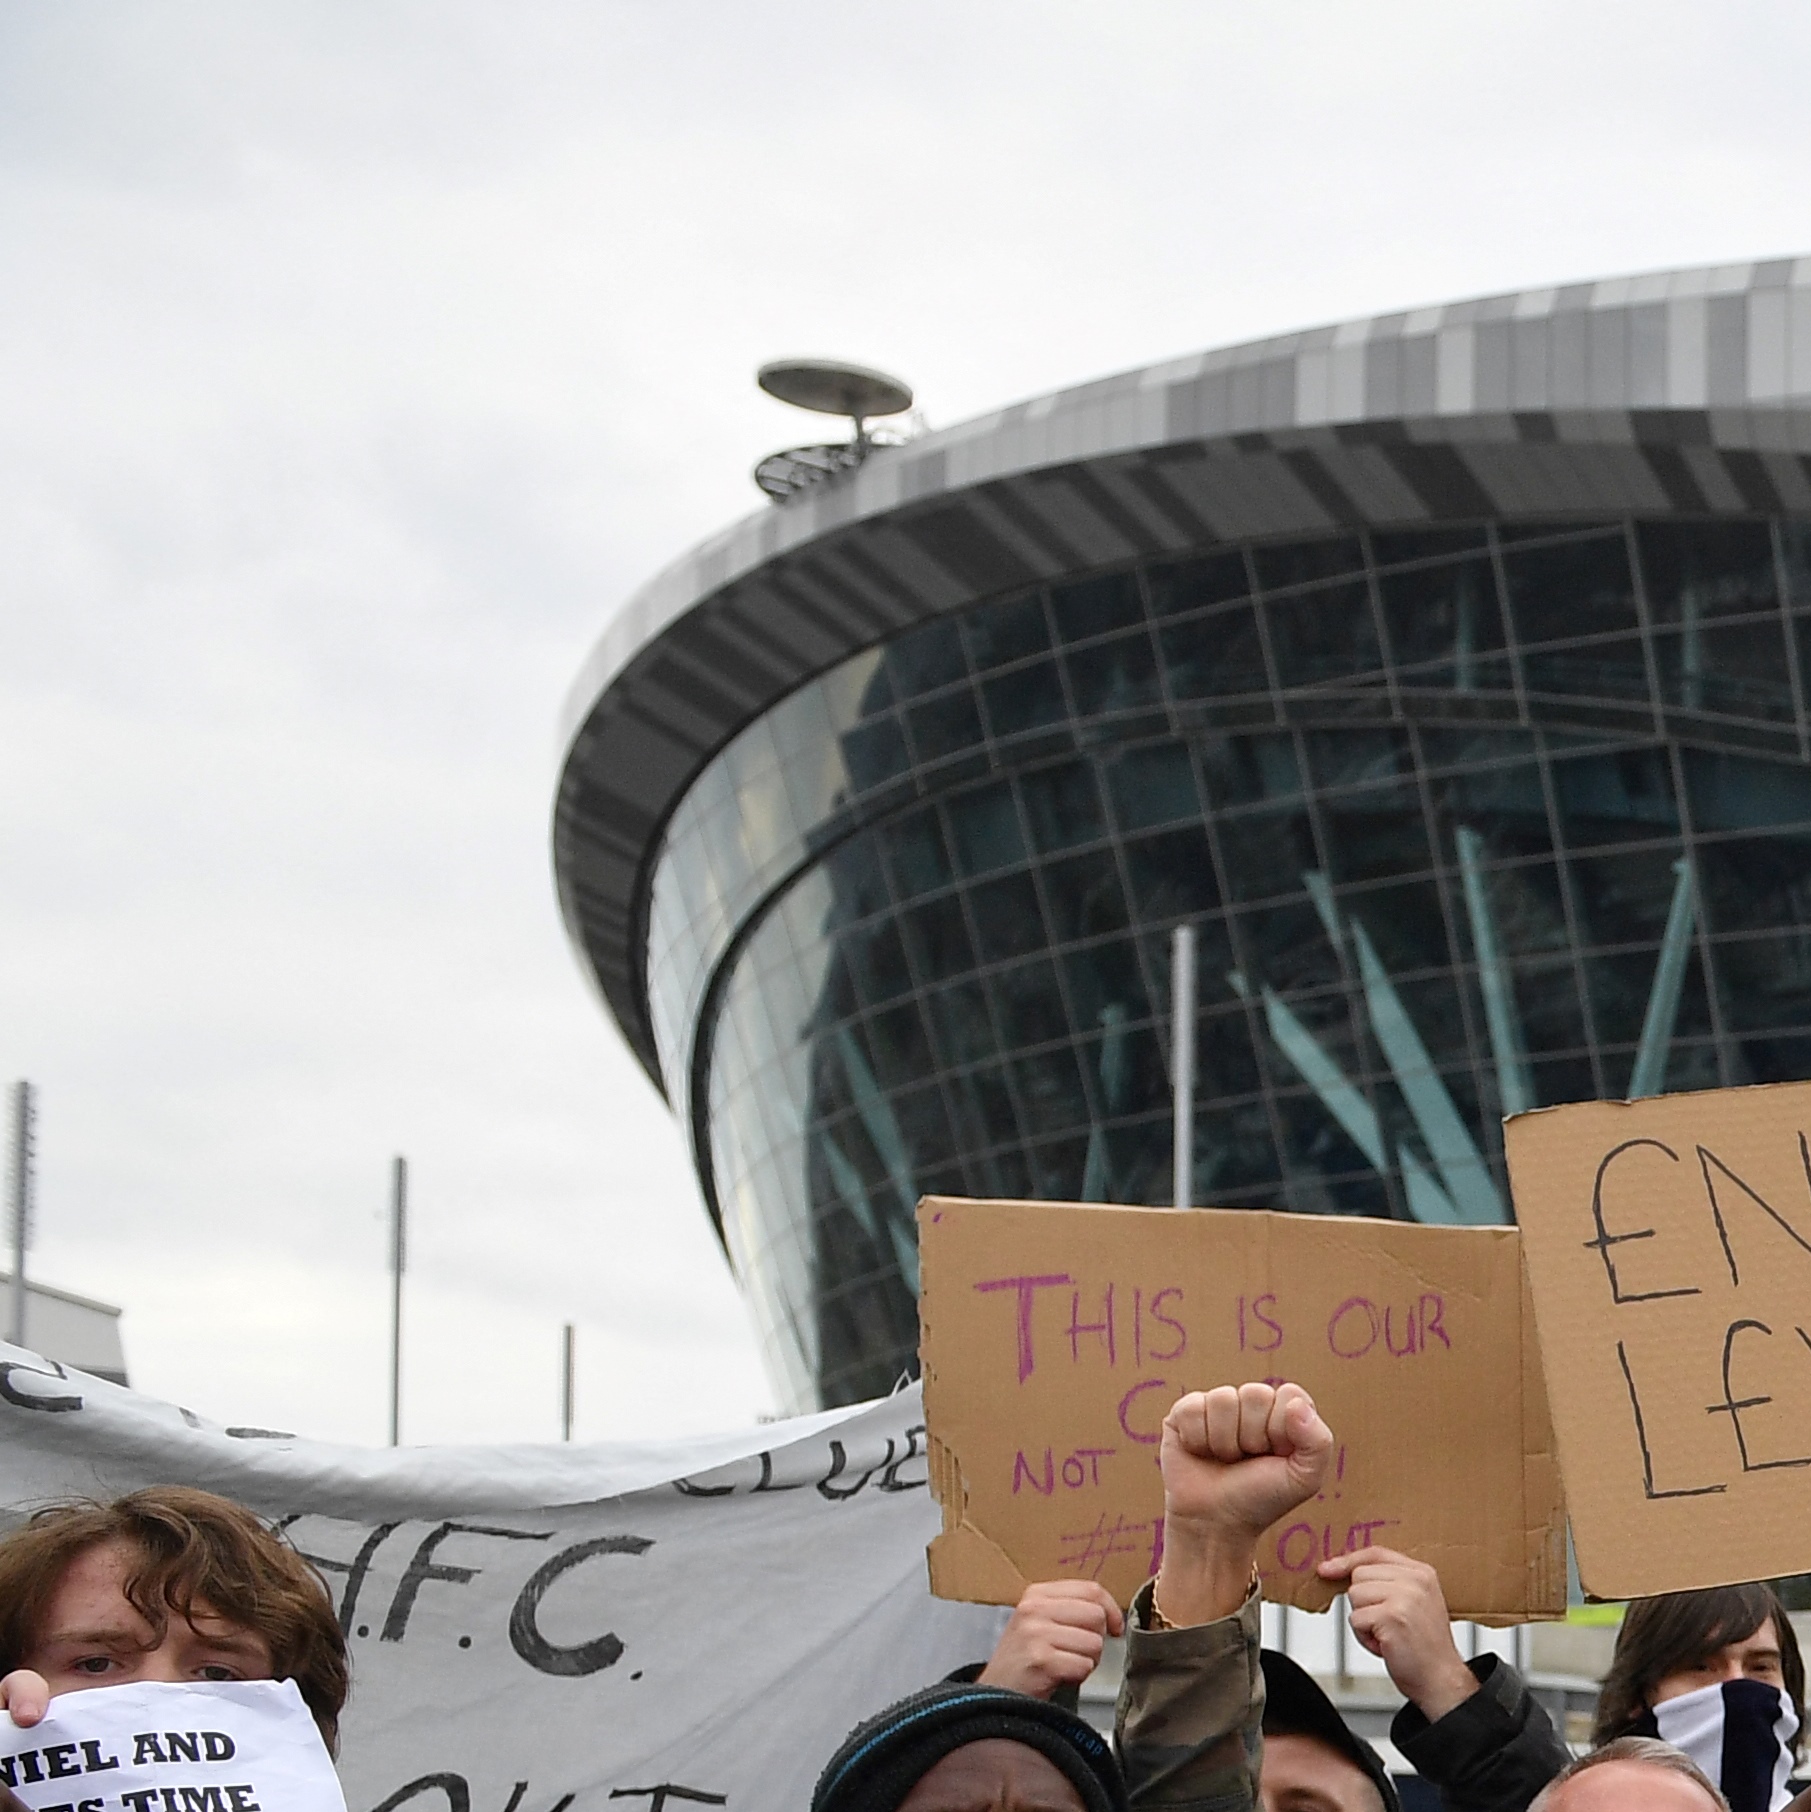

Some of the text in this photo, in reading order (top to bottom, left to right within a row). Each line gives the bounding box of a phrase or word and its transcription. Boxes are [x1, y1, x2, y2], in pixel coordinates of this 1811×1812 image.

[973, 1273, 1451, 1384] THIS IS OUR
[1012, 1447, 1117, 1496] NOT
[133, 1732, 236, 1765] AND
